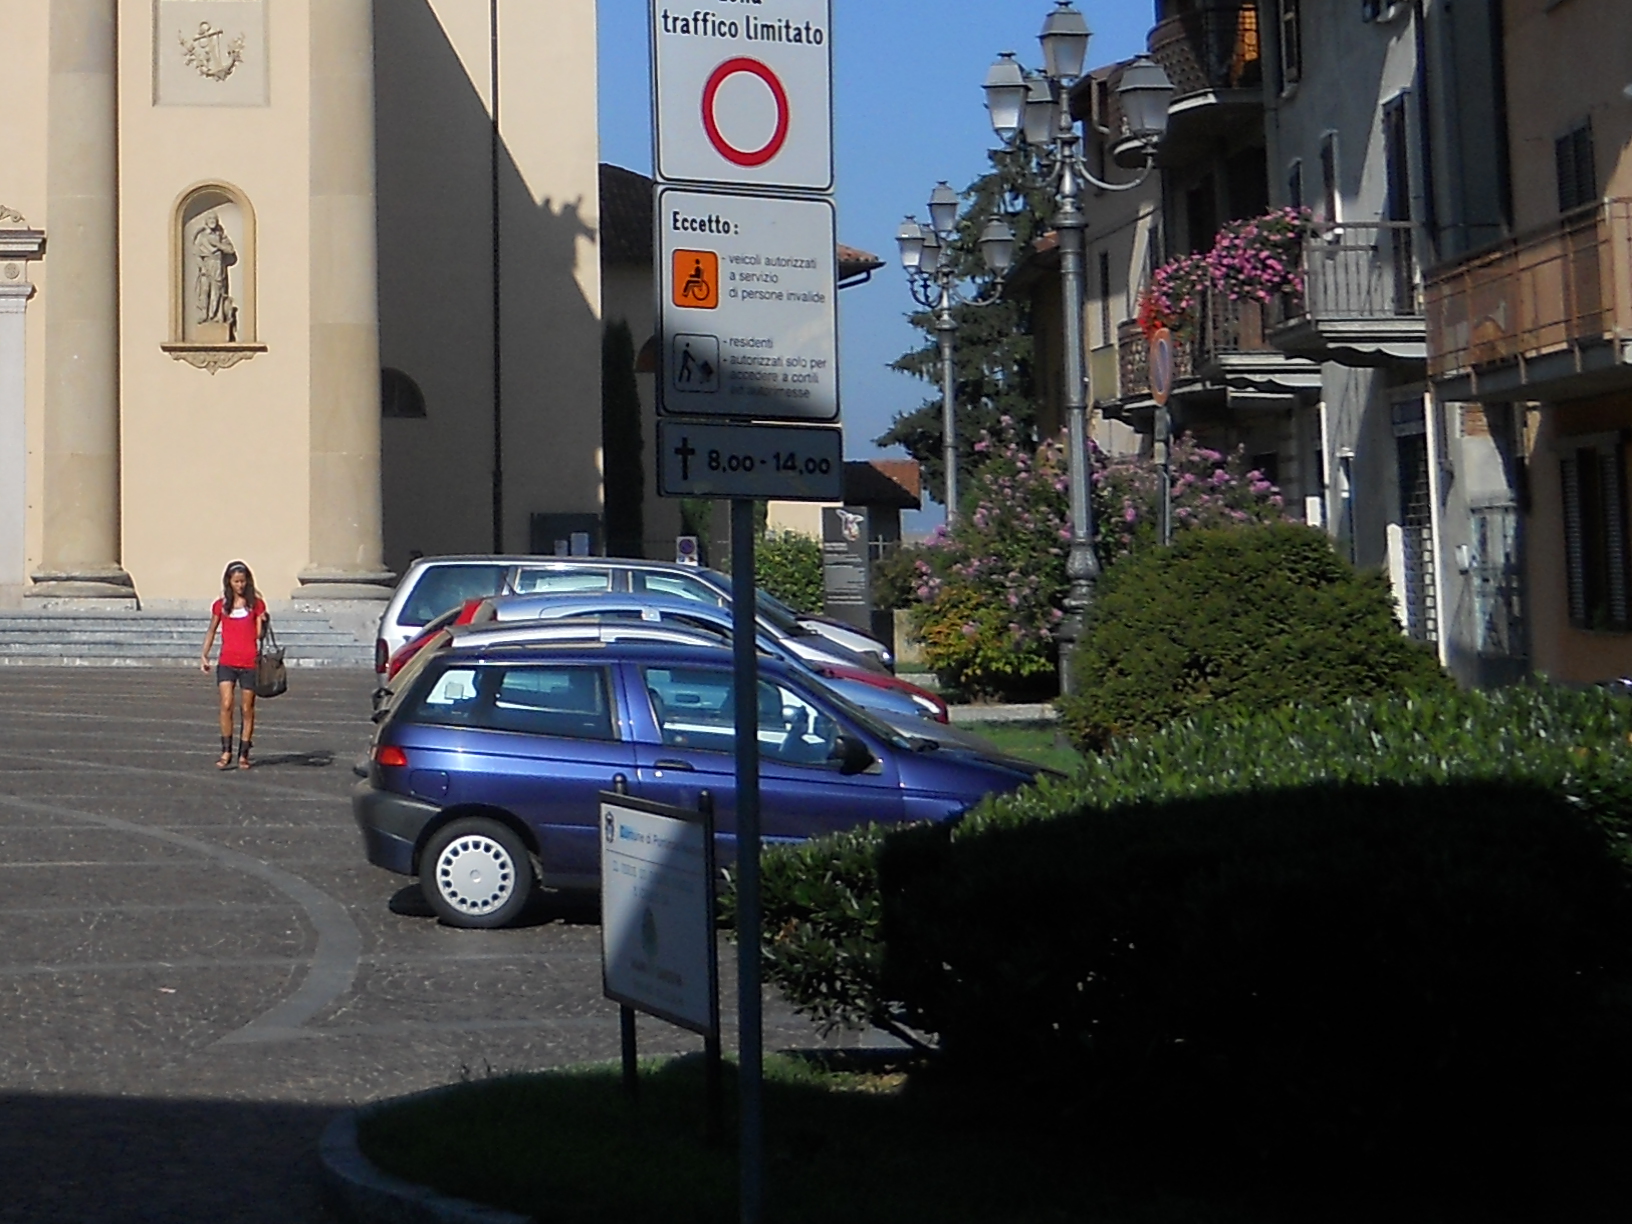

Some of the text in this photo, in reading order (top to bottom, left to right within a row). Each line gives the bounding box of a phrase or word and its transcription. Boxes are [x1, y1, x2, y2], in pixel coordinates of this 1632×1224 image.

[661, 9, 824, 45] traffico limitato
[672, 210, 739, 236] Eccetto:
[728, 253, 761, 265] veicoli
[764, 256, 817, 269] autorizzati
[729, 270, 778, 283] a servizio
[728, 287, 825, 303] di persone invalide
[729, 337, 773, 348] residenti
[730, 355, 783, 367] autorizzati
[786, 356, 807, 368] solo
[810, 358, 827, 370] per
[782, 373, 789, 382] a
